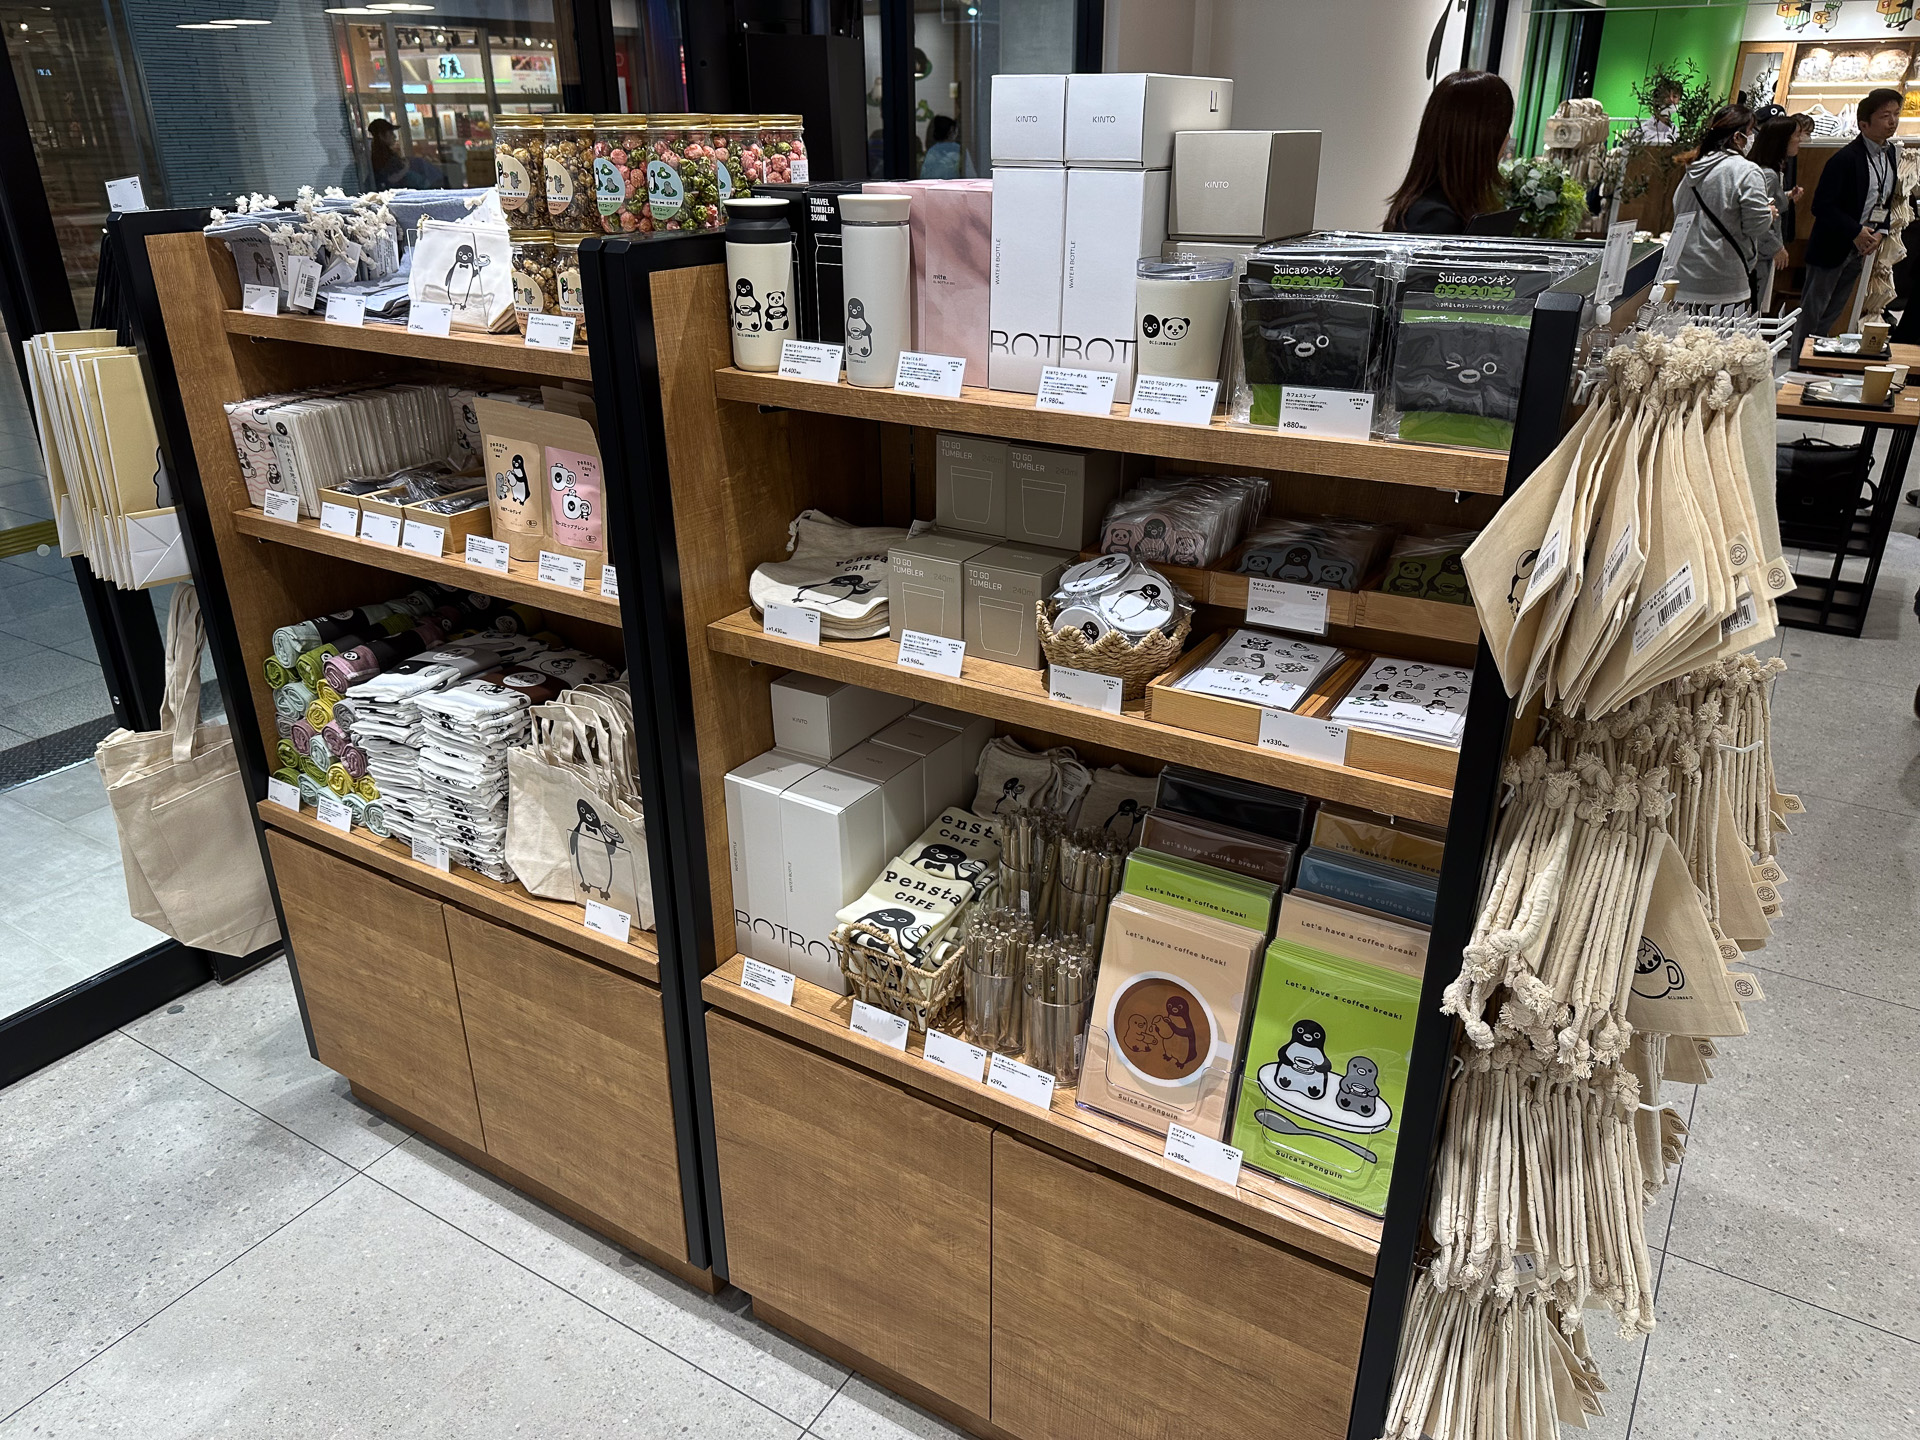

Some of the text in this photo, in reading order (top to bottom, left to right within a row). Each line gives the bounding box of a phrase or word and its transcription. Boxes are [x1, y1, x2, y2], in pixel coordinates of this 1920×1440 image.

[520, 85, 551, 94] Sushi
[1015, 115, 1038, 123] KINTO
[1092, 115, 1116, 124] KINTO
[1204, 180, 1230, 189] KINTO
[810, 198, 829, 206] TRAVEL
[810, 206, 835, 214] TUMBLER
[810, 214, 828, 222] 350ML
[1273, 264, 1343, 276] Suicaのペンギン
[1273, 276, 1343, 289] カフェスリーブ
[1437, 272, 1515, 286] Suicaのペンギン
[1436, 285, 1513, 299] カフェスリーブ
[941, 440, 961, 450] TO GO
[941, 449, 973, 460] TUMBLER
[1012, 452, 1032, 462] TO GO
[1012, 461, 1045, 473] TUMBLER
[844, 564, 872, 572] CAFE
[892, 557, 912, 567] TO GO
[892, 566, 924, 578] TUMBLER
[969, 569, 990, 580] TO GO
[969, 578, 1003, 591] TUMBLER
[792, 717, 808, 725] KINTO
[822, 784, 840, 792] KINTO
[939, 829, 980, 847] CAFE
[1162, 839, 1180, 849] Let's
[1183, 843, 1200, 853] have
[1211, 853, 1235, 863] coffee
[1238, 858, 1264, 871] break!
[1336, 842, 1357, 853] Let's
[1359, 848, 1380, 858] have
[1391, 856, 1417, 868] coffee
[1421, 863, 1441, 874] brea
[884, 870, 962, 907] Pensta
[895, 892, 935, 910] CAFE
[1145, 885, 1163, 895] Let's
[1166, 889, 1185, 901] have
[1194, 900, 1219, 911] coffee
[1221, 906, 1247, 919] break!
[1320, 882, 1341, 893] Let's
[1345, 888, 1364, 899] have
[1376, 898, 1403, 910] coffee
[1301, 920, 1322, 932] Let's
[1325, 926, 1346, 938] have
[1357, 936, 1385, 949] coffee
[1388, 943, 1418, 957] break!
[1125, 930, 1144, 940] Let's
[1146, 935, 1165, 947] have
[1174, 946, 1198, 958] coffee
[1201, 953, 1227, 967] break!
[1285, 979, 1306, 991] Let's
[1309, 985, 1331, 998] have
[1342, 996, 1370, 1011] coffee
[1373, 1005, 1403, 1020] break!
[1118, 1092, 1179, 1121] Suica's Penguin
[1275, 1149, 1344, 1181] Suica's Penguin
